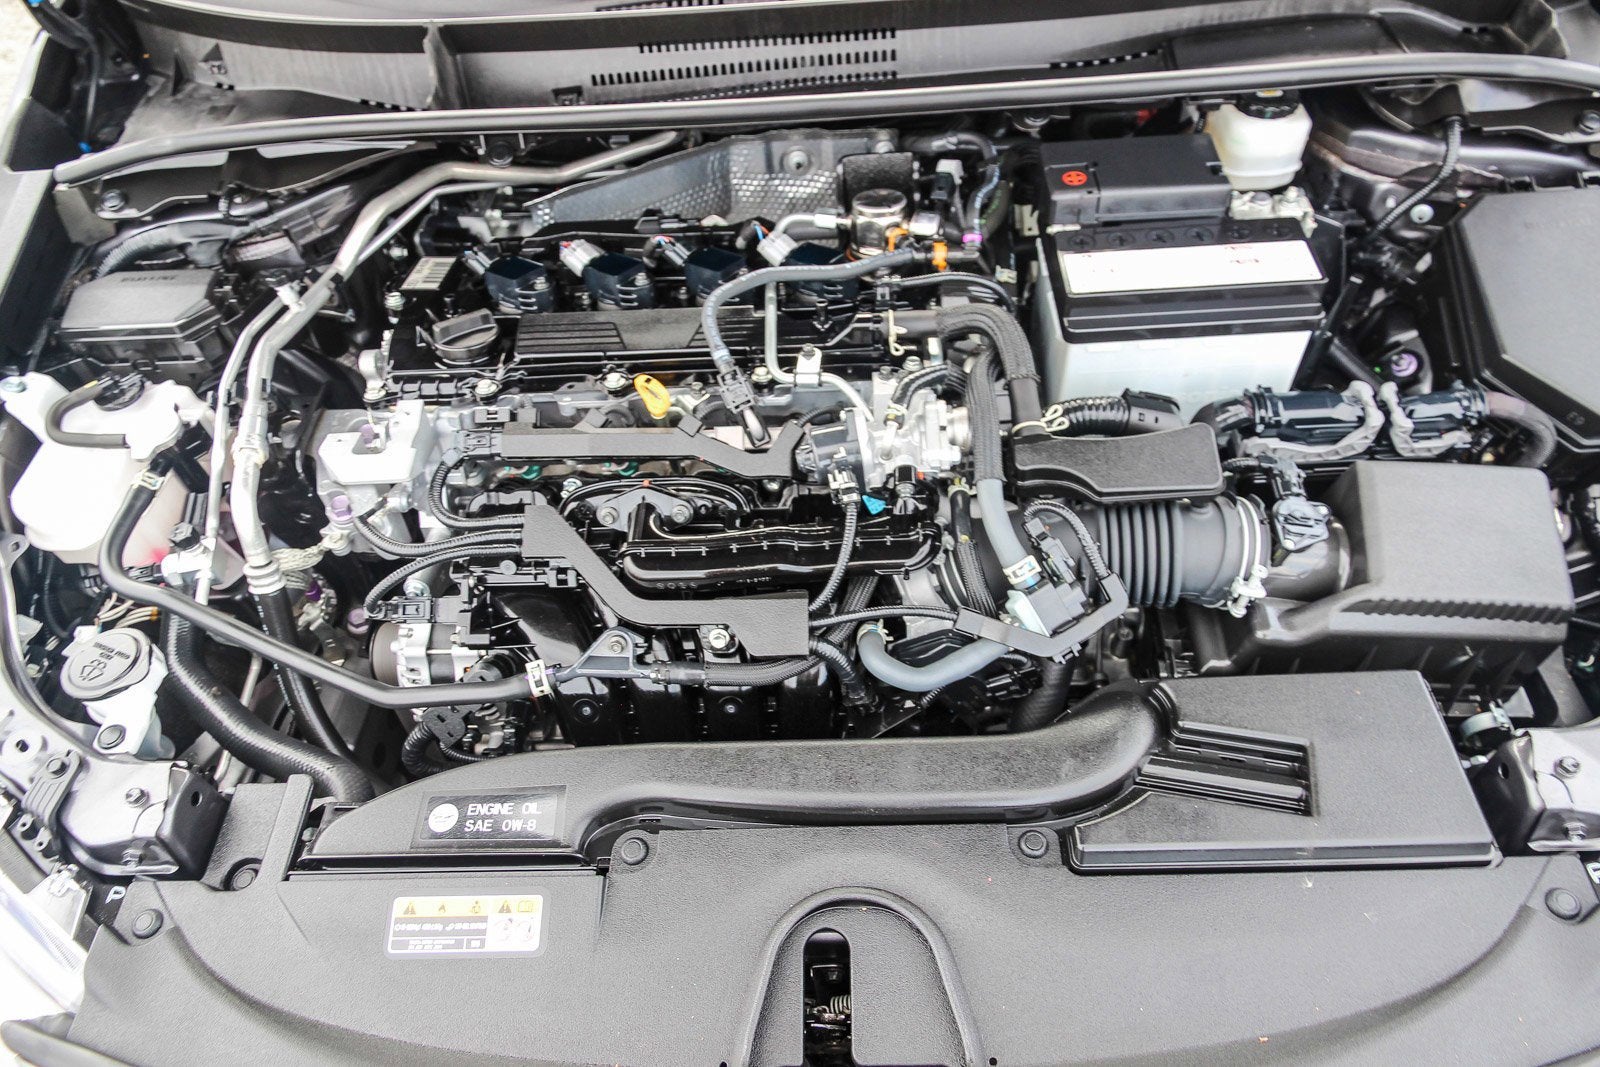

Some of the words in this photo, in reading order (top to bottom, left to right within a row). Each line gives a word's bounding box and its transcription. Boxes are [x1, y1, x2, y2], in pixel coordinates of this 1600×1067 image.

[467, 803, 514, 816] ENGINE
[522, 802, 542, 815] OIL
[464, 819, 494, 832] SAE
[502, 819, 537, 832] 0W-8
